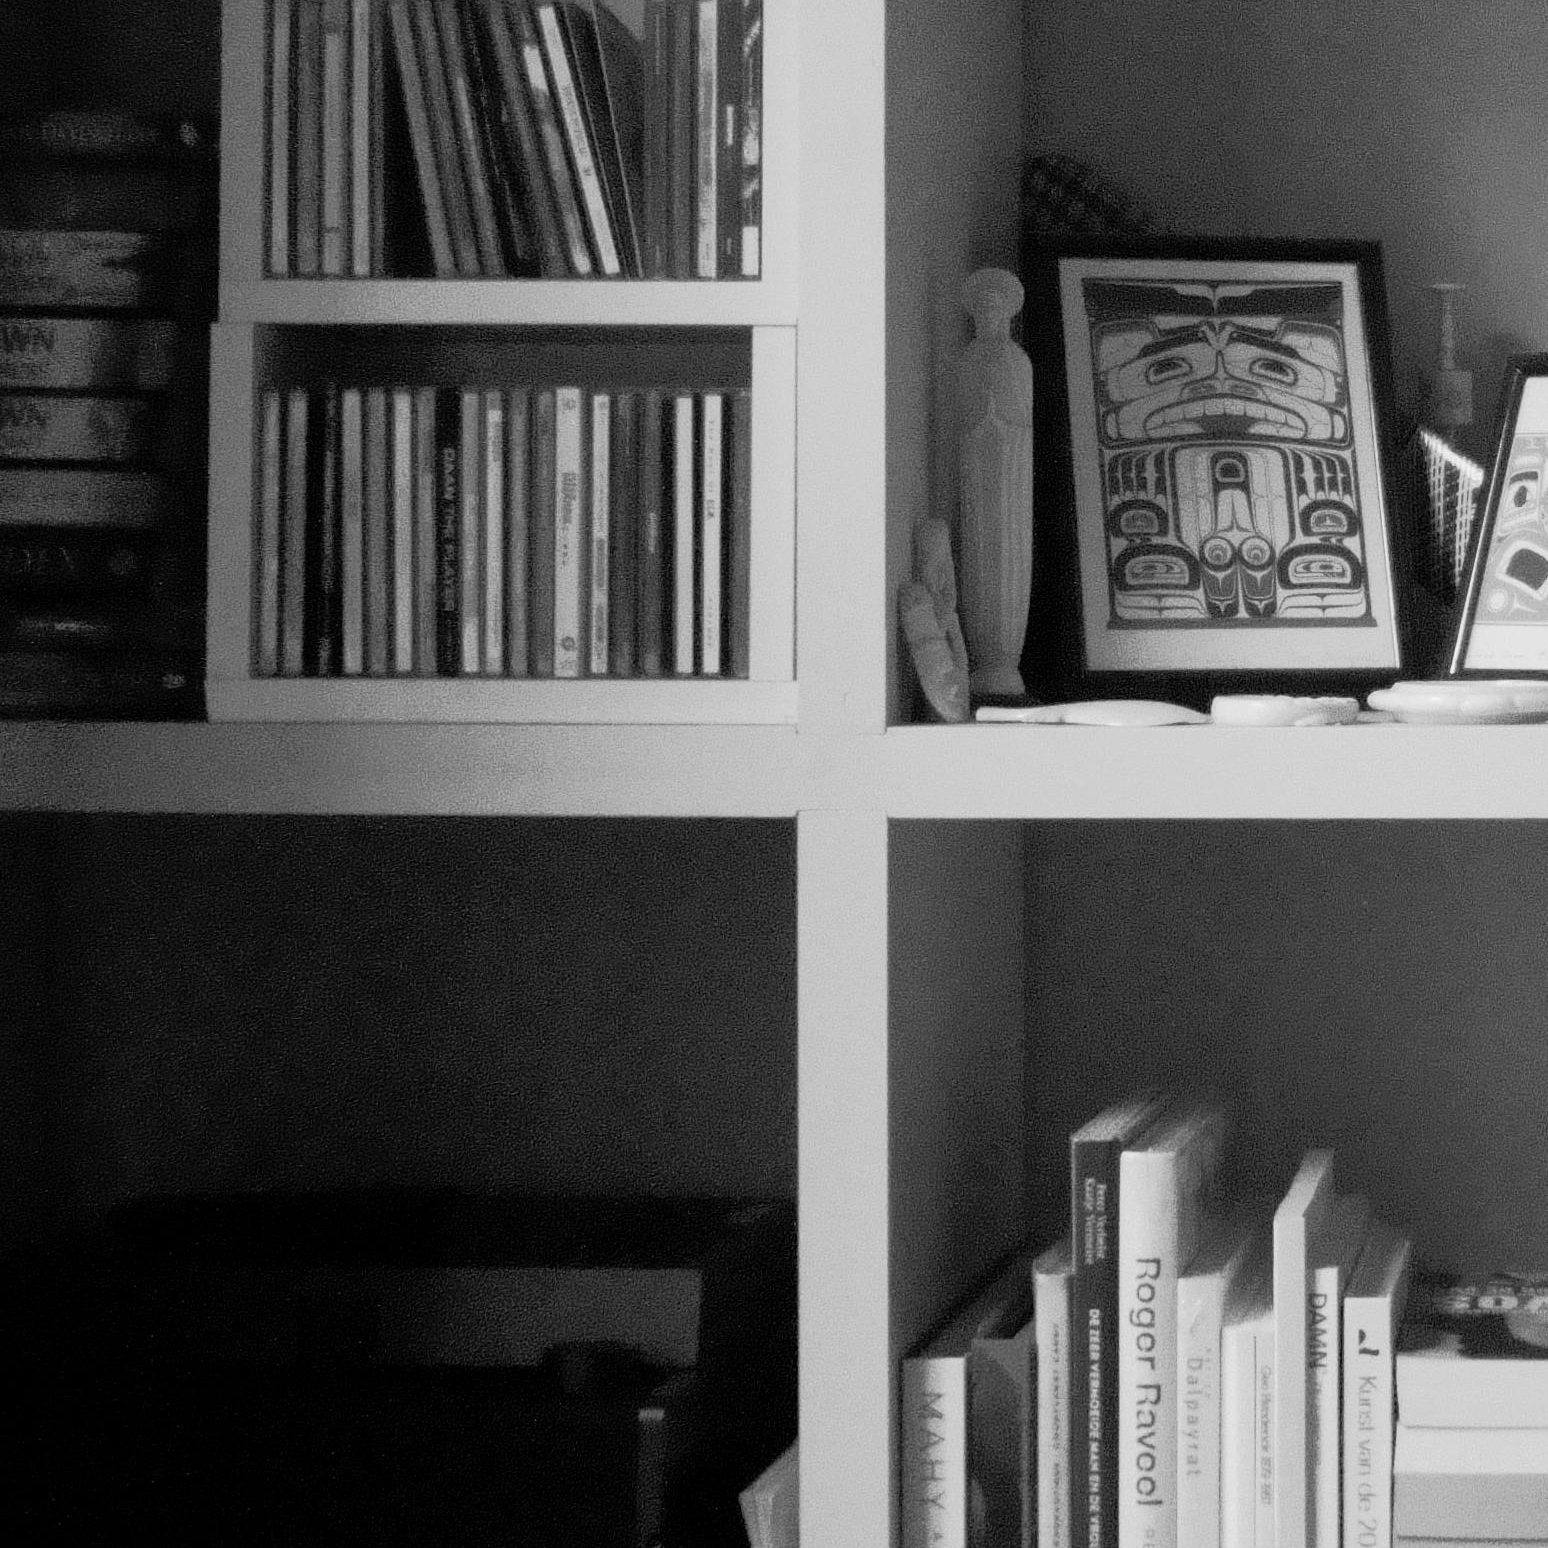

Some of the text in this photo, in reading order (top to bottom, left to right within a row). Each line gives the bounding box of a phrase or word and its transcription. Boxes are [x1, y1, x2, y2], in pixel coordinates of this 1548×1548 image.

[1089, 1308, 1102, 1327] DE
[1129, 1256, 1163, 1372] Roger
[1089, 1329, 1102, 1361] ZEER
[1089, 1363, 1102, 1441] VERMOEIDE
[1181, 1356, 1204, 1479] Dalpayrat
[1357, 1375, 1379, 1432] Kunst
[919, 1390, 947, 1513] MAHY
[1089, 1441, 1102, 1472] MAN
[1135, 1382, 1165, 1508] Raveel
[1357, 1438, 1377, 1478] van
[1089, 1474, 1102, 1493] EN
[1089, 1494, 1102, 1512] DE
[1357, 1481, 1379, 1513] de
